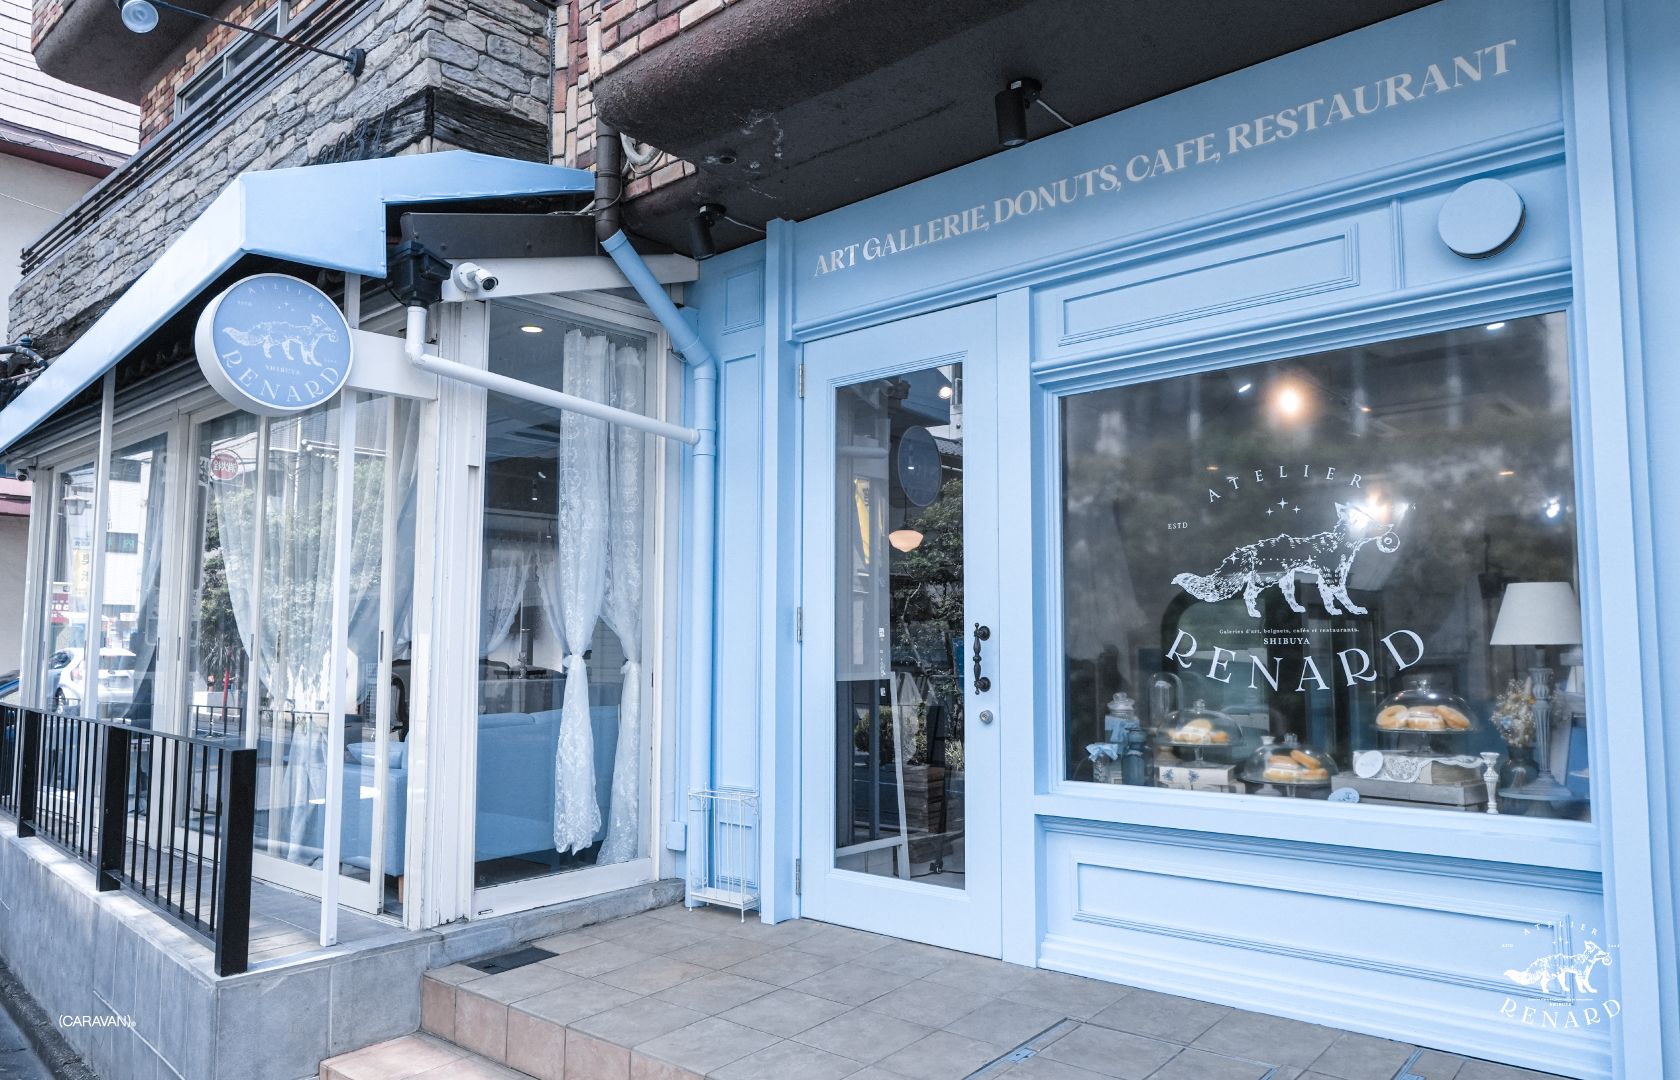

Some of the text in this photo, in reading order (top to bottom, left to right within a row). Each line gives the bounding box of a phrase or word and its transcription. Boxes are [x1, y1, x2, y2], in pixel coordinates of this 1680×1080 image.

[813, 39, 1516, 277] ART GALLERIE, DONUTS, CAFE, RESTAURANT
[222, 350, 339, 402] RENARD
[1208, 464, 1363, 503] ATELIER
[1167, 521, 1189, 530] ESTD
[1165, 629, 1424, 692] RENARD
[1263, 637, 1311, 645] SHIBUYA
